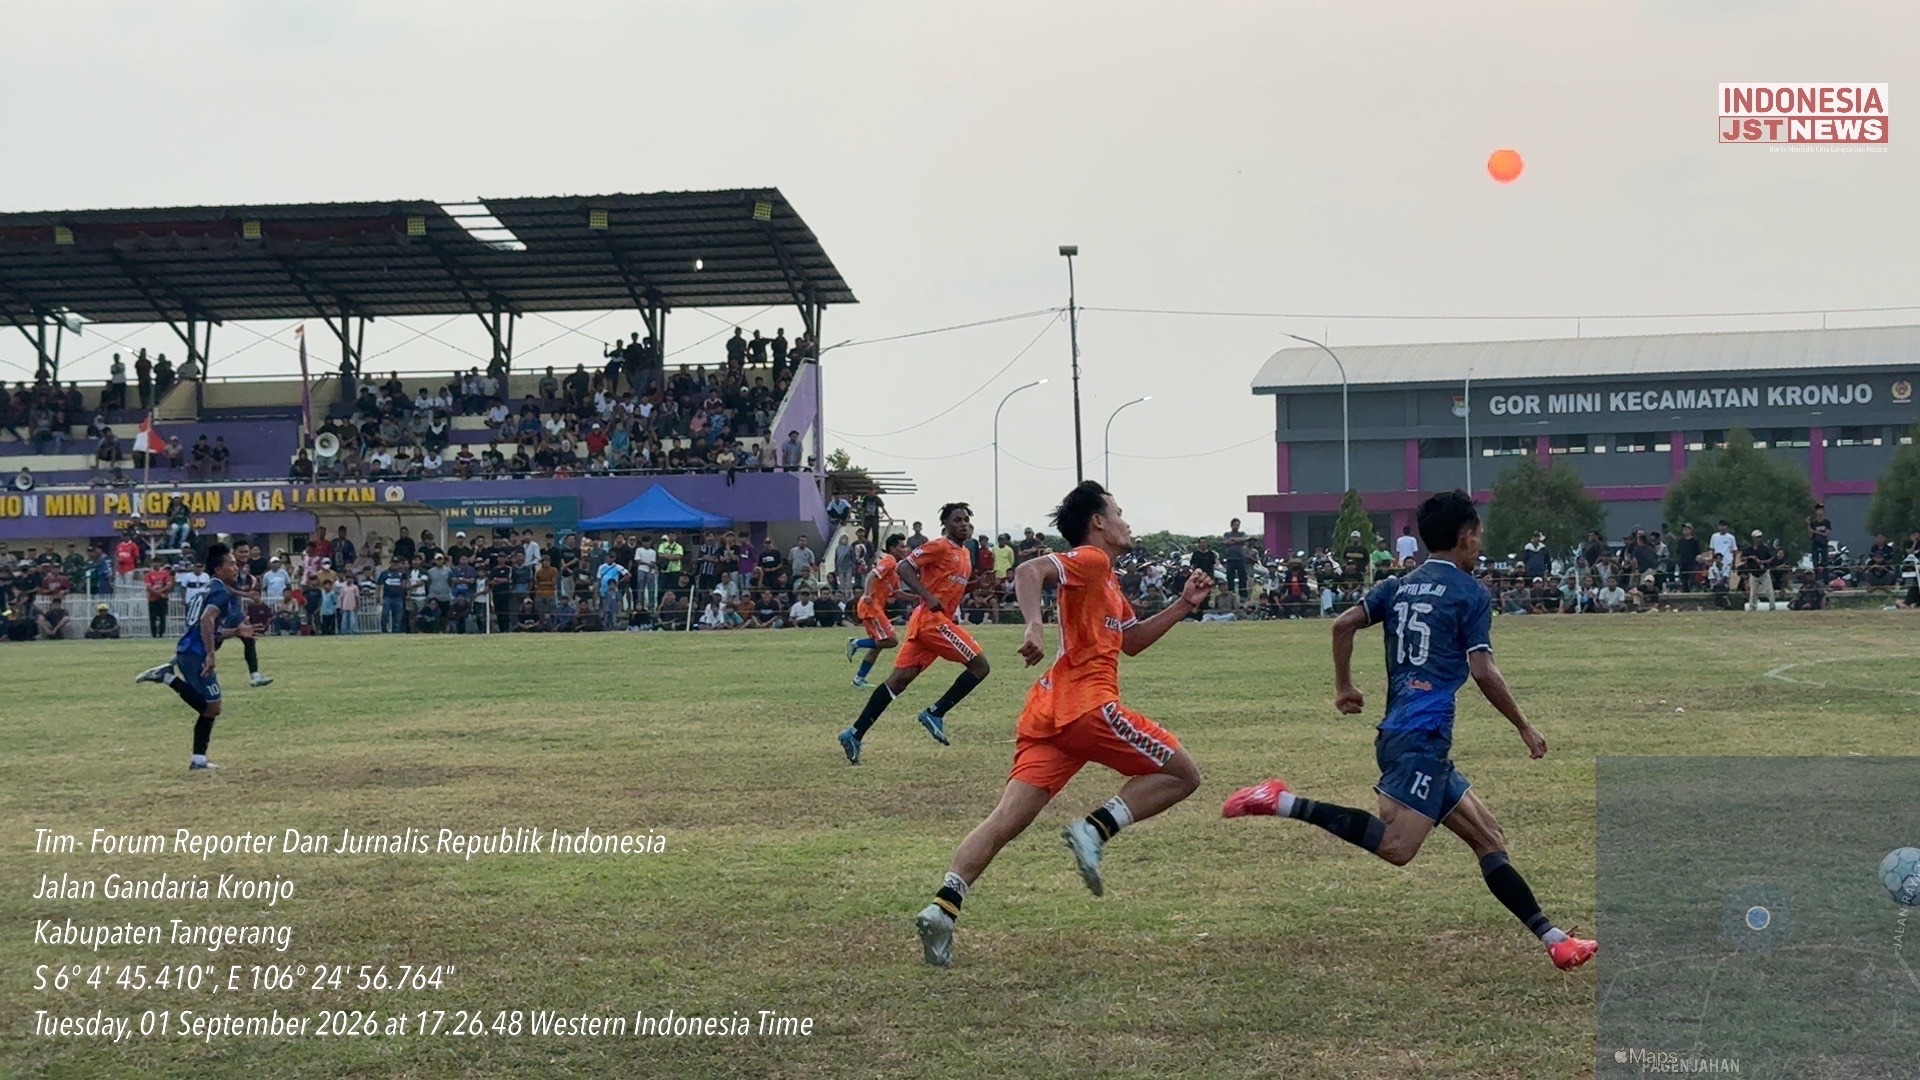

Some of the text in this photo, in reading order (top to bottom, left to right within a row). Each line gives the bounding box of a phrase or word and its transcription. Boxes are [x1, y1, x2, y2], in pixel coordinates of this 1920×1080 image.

[1489, 383, 1873, 415] GOR MINI KECAMATAN KRONJO
[45, 494, 97, 517] MINI
[227, 488, 286, 512] JAGA
[522, 504, 553, 516] CUP
[1393, 601, 1434, 666] 15
[206, 683, 220, 696] 10
[1410, 771, 1433, 800] 15
